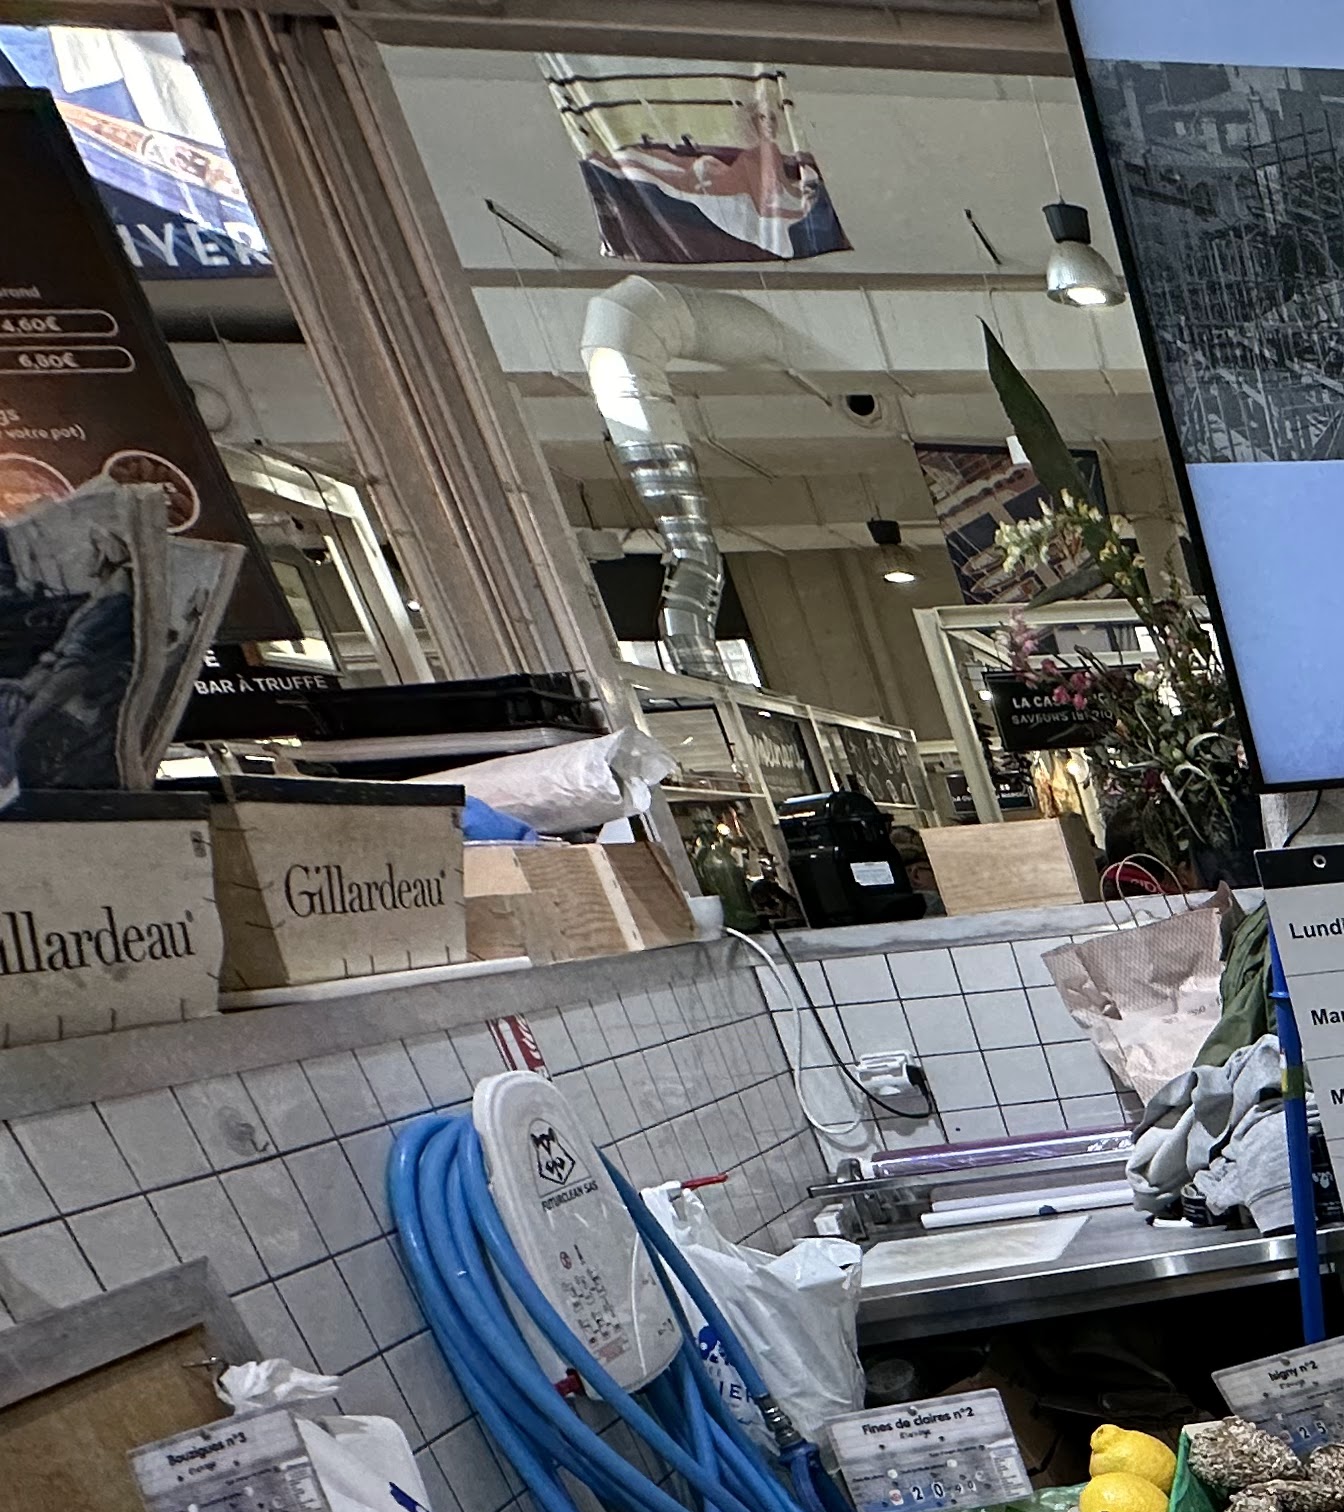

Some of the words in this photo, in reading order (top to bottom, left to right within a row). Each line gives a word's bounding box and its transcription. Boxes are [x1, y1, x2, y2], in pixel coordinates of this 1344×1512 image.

[194, 680, 235, 695] BAR
[240, 674, 253, 692] À
[253, 675, 328, 692] TRUFFE
[1012, 697, 1031, 709] LA
[284, 866, 446, 919] Gillardeau
[583, 1180, 599, 1194] SAS
[861, 1422, 893, 1436] Fines
[895, 1418, 912, 1430] de
[913, 1412, 951, 1427] claires
[953, 1406, 975, 1420] n°2
